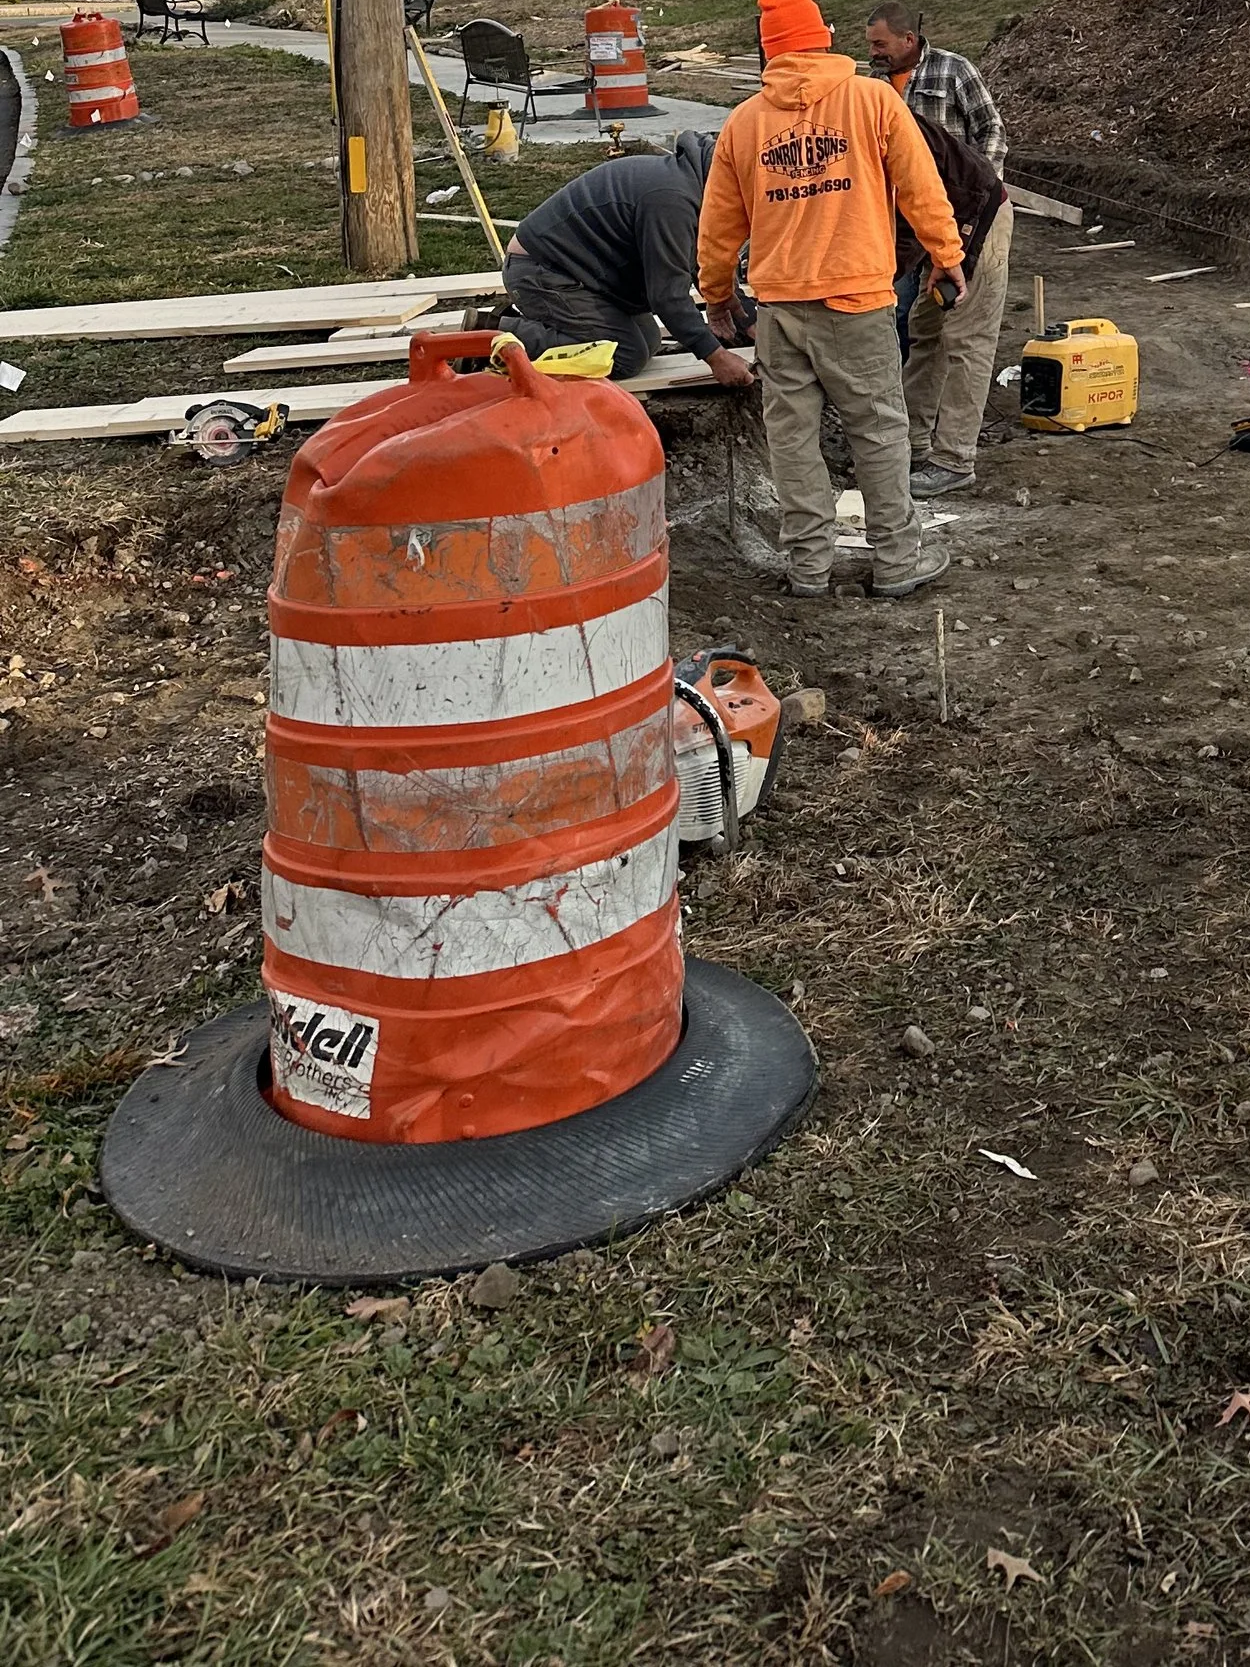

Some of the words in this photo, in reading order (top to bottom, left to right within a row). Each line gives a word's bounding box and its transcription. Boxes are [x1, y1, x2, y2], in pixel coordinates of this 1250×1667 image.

[761, 137, 804, 166] CONROY
[815, 136, 848, 161] SONS
[1088, 389, 1124, 404] KIPOR
[283, 1050, 353, 1090] Brothers
